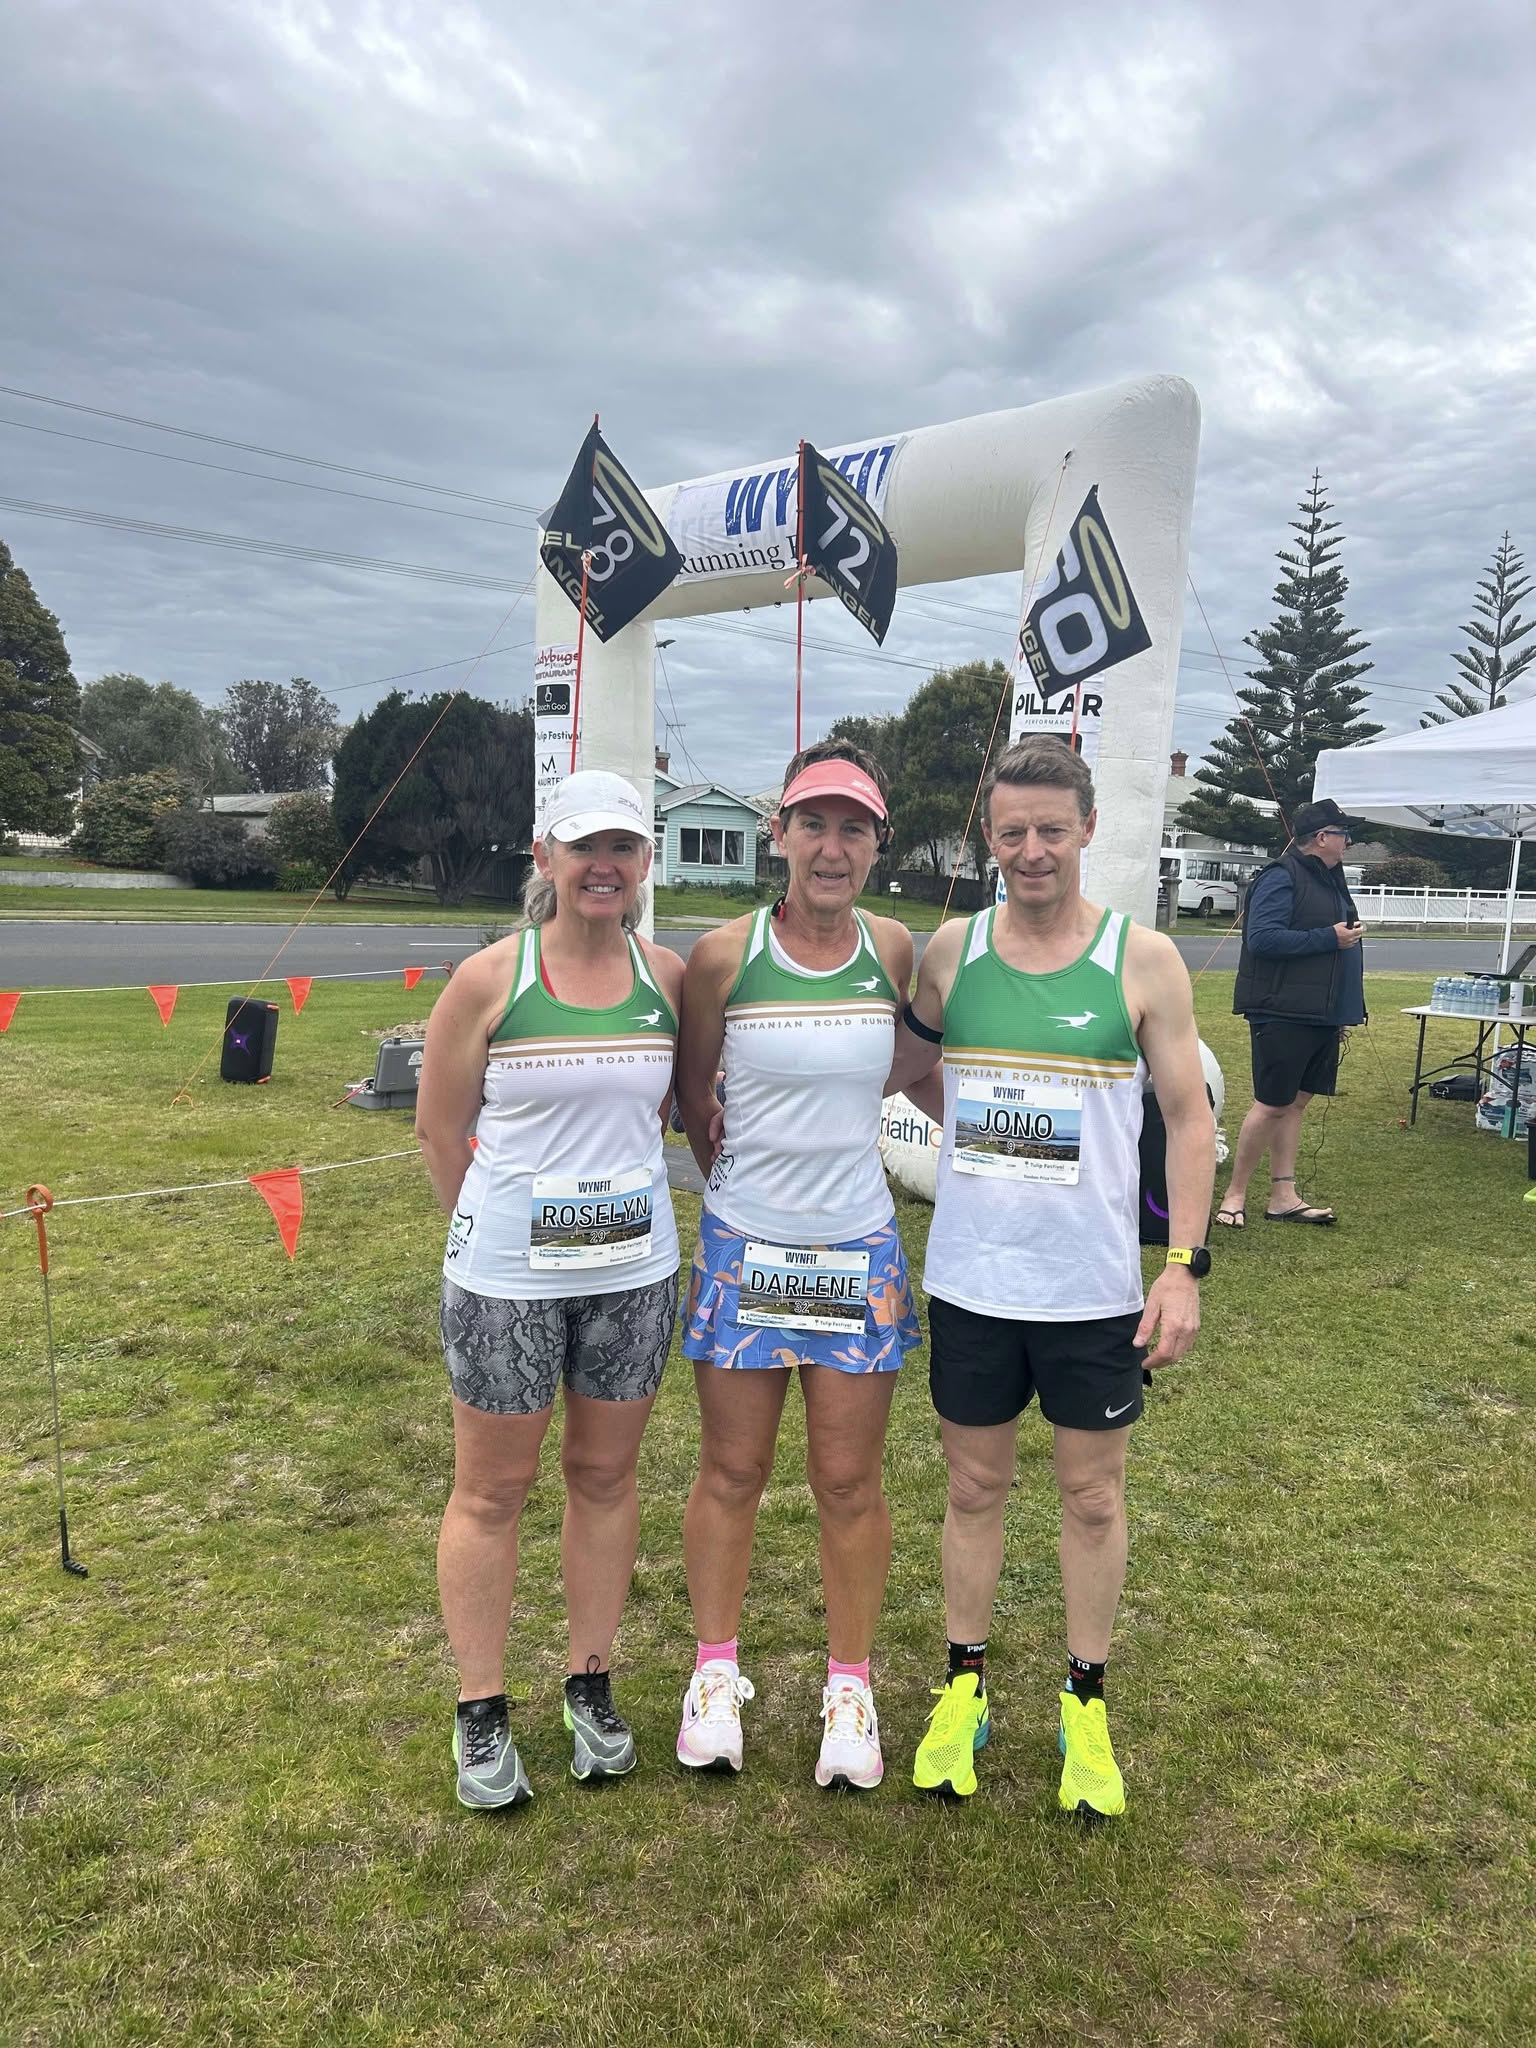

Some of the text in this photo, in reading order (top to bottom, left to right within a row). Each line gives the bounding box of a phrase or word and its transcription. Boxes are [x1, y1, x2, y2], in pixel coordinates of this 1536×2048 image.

[725, 445, 896, 536] WYFIT
[818, 496, 870, 590] 72
[1015, 693, 1103, 718] PILLAR
[733, 1021, 803, 1031] TASMANIAN
[814, 1018, 852, 1027] ROAD
[501, 1057, 585, 1070] TASMANIAN
[597, 1055, 635, 1065] ROAD
[1012, 1072, 1051, 1084] ROAD
[993, 1086, 1025, 1101] WYNFIT
[977, 1107, 1054, 1140] JONO
[1007, 1141, 1015, 1153] 9
[578, 1180, 611, 1193] WYNFIT
[541, 1193, 649, 1227] ROSELYN
[589, 1230, 606, 1243] 29
[785, 1251, 818, 1265] WYNFIT
[749, 1269, 862, 1299] DARLENE
[793, 1300, 810, 1314] 32
[1077, 1660, 1090, 1670] TO
